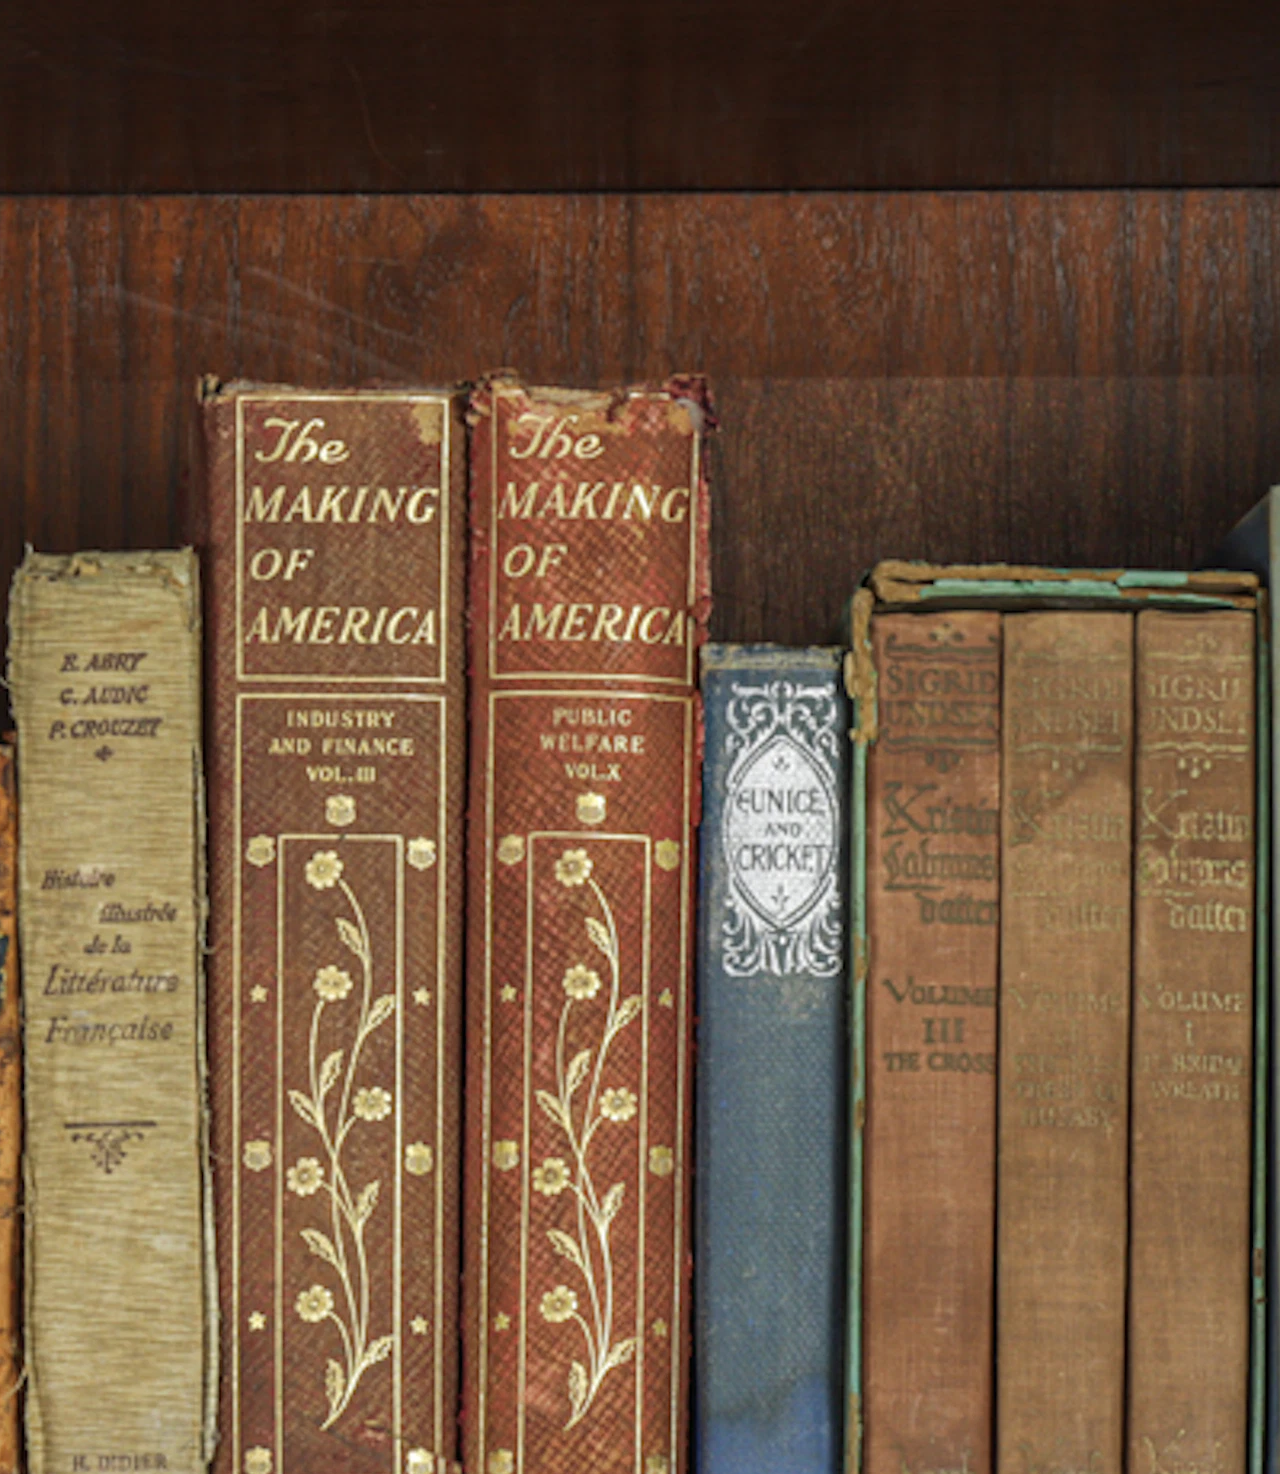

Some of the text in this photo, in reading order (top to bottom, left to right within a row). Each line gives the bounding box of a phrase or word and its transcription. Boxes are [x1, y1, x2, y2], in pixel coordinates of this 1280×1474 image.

[254, 417, 351, 465] The
[509, 413, 605, 459] The
[244, 484, 440, 524] MAKING
[498, 482, 690, 523] MAKING
[250, 548, 315, 581] OF
[503, 544, 569, 577] OF
[245, 606, 437, 646] AMERICA
[498, 603, 686, 646] AMERICA
[84, 652, 148, 672] ABRY
[886, 664, 997, 696] SIGRID
[60, 685, 149, 705] C. AUDIC
[71, 717, 163, 738] CROUZET
[287, 709, 395, 728] INDUSTRY
[553, 708, 632, 727] PUBLIC
[886, 702, 997, 728] UNDSET
[268, 737, 415, 757] AND FINANCE
[540, 733, 645, 754] WELFARE
[736, 788, 826, 815] EUNICE
[765, 821, 802, 838] AND
[736, 844, 827, 873] CRICKET
[43, 963, 179, 996] Littérature
[45, 1015, 174, 1046] Française
[922, 1017, 966, 1044] III
[884, 1053, 919, 1072] THE
[928, 1053, 996, 1075] CROSS
